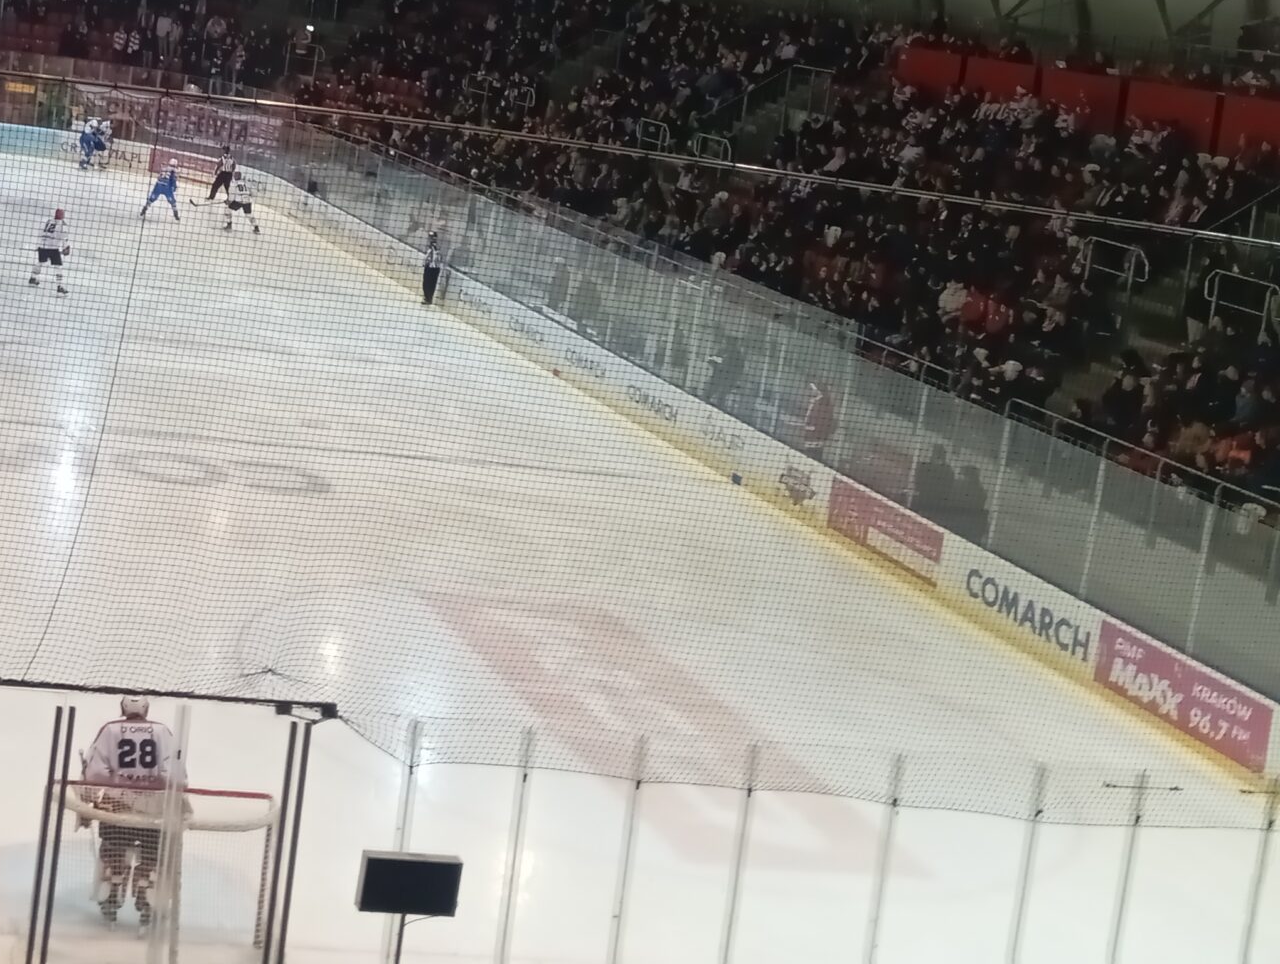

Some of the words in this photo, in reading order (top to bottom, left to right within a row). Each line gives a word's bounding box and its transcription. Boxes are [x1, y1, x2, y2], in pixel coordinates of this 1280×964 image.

[43, 222, 56, 233] 12
[966, 568, 1091, 662] COMARCH
[1190, 681, 1254, 722] KRAKÓW
[117, 738, 158, 769] 28
